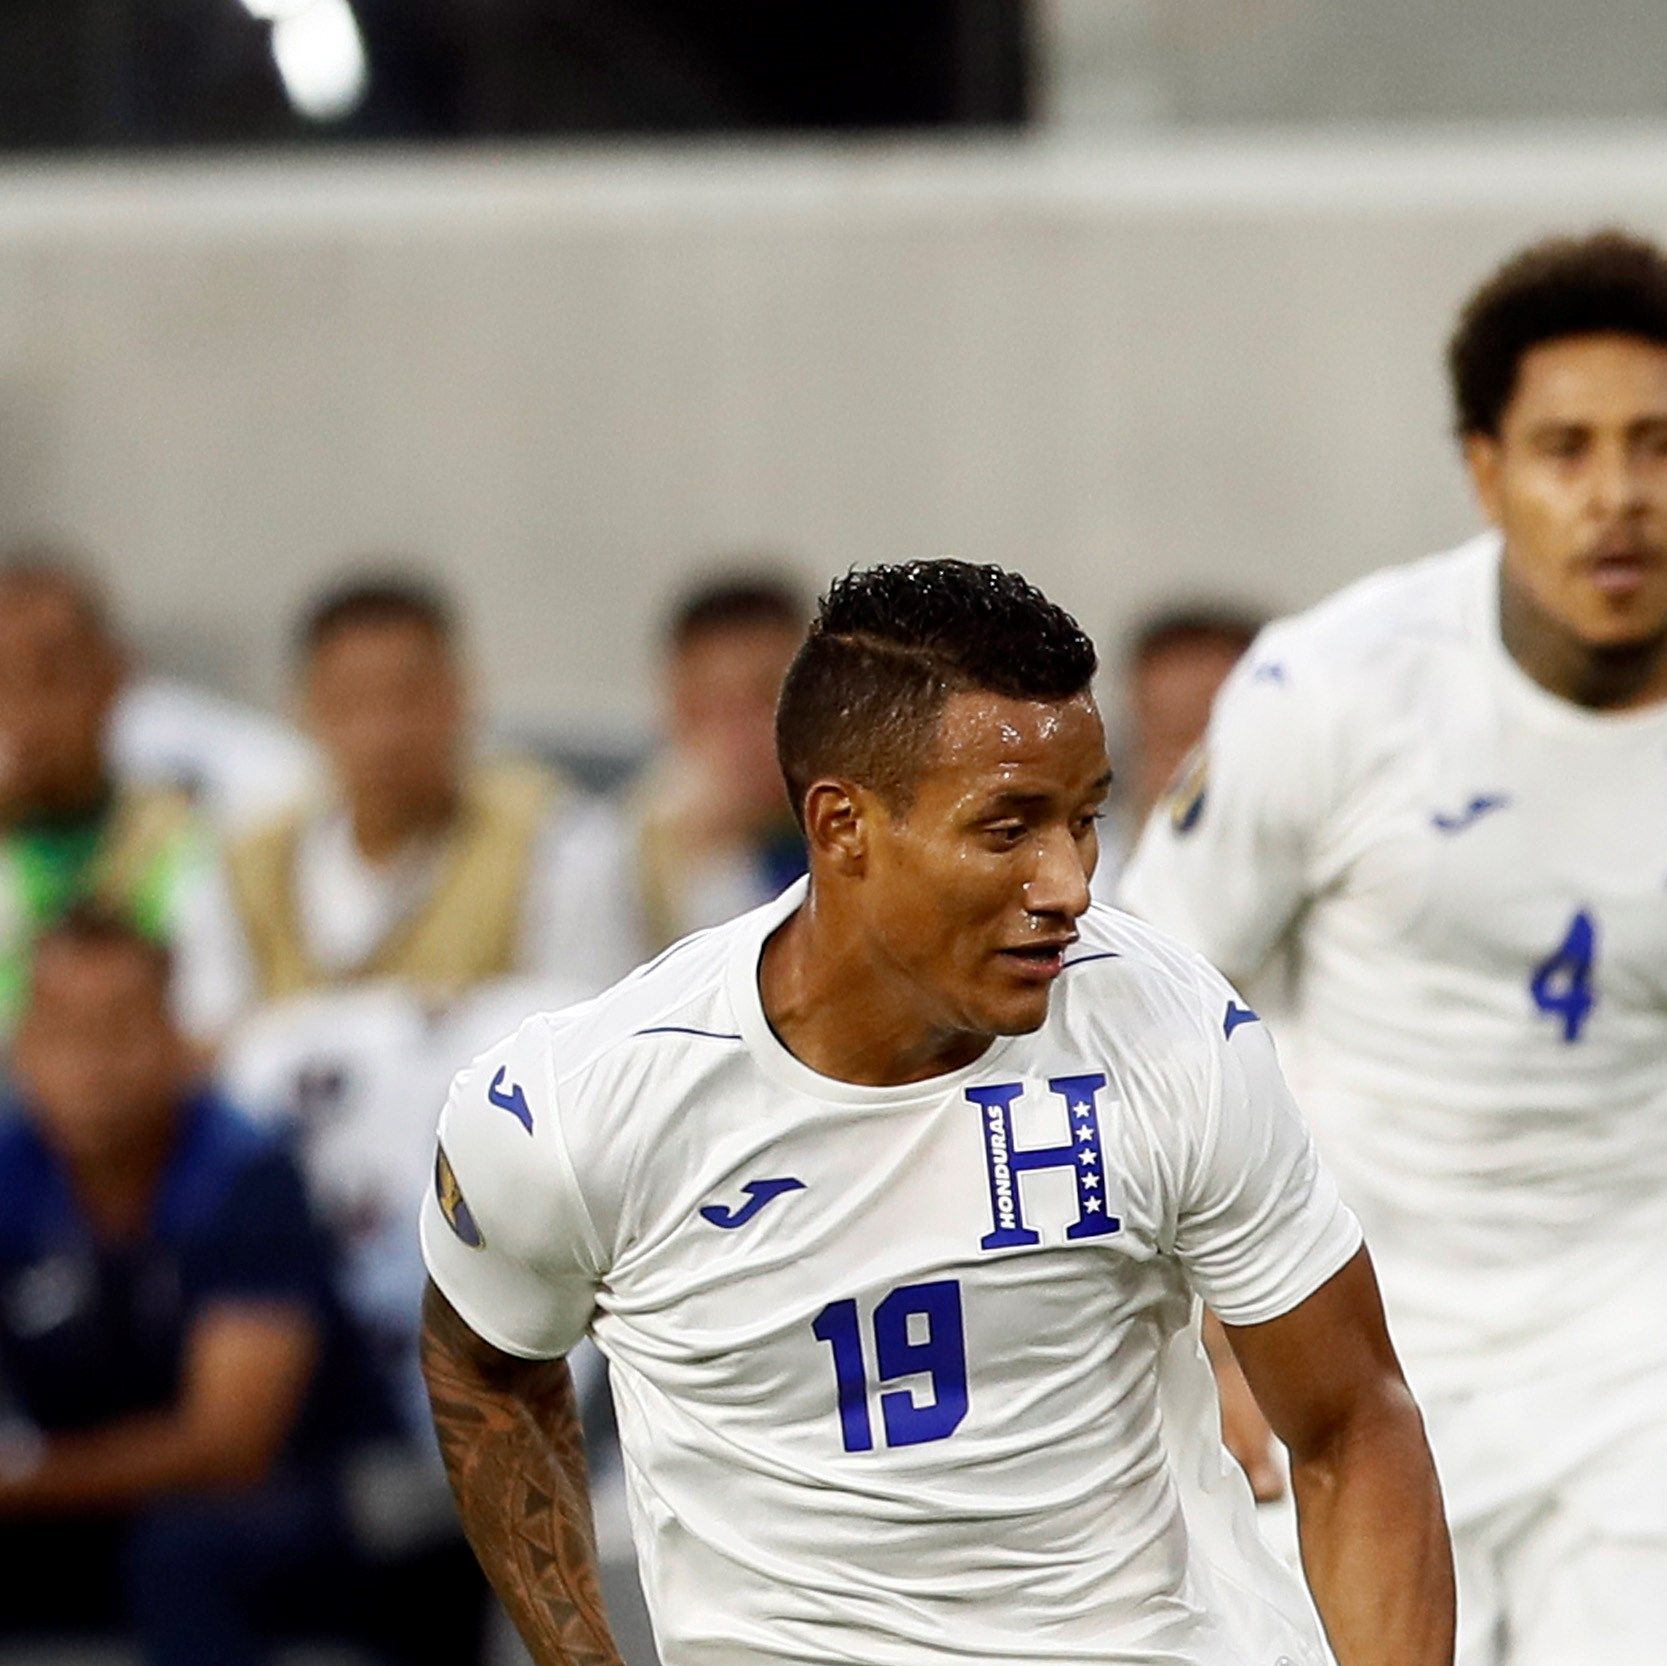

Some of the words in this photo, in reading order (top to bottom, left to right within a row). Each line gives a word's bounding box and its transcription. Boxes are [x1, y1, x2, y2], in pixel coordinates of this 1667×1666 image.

[1529, 905, 1596, 1045] 4
[965, 1072, 1121, 1251] H
[987, 1105, 1017, 1230] HONDURAS
[812, 1279, 971, 1452] 19
